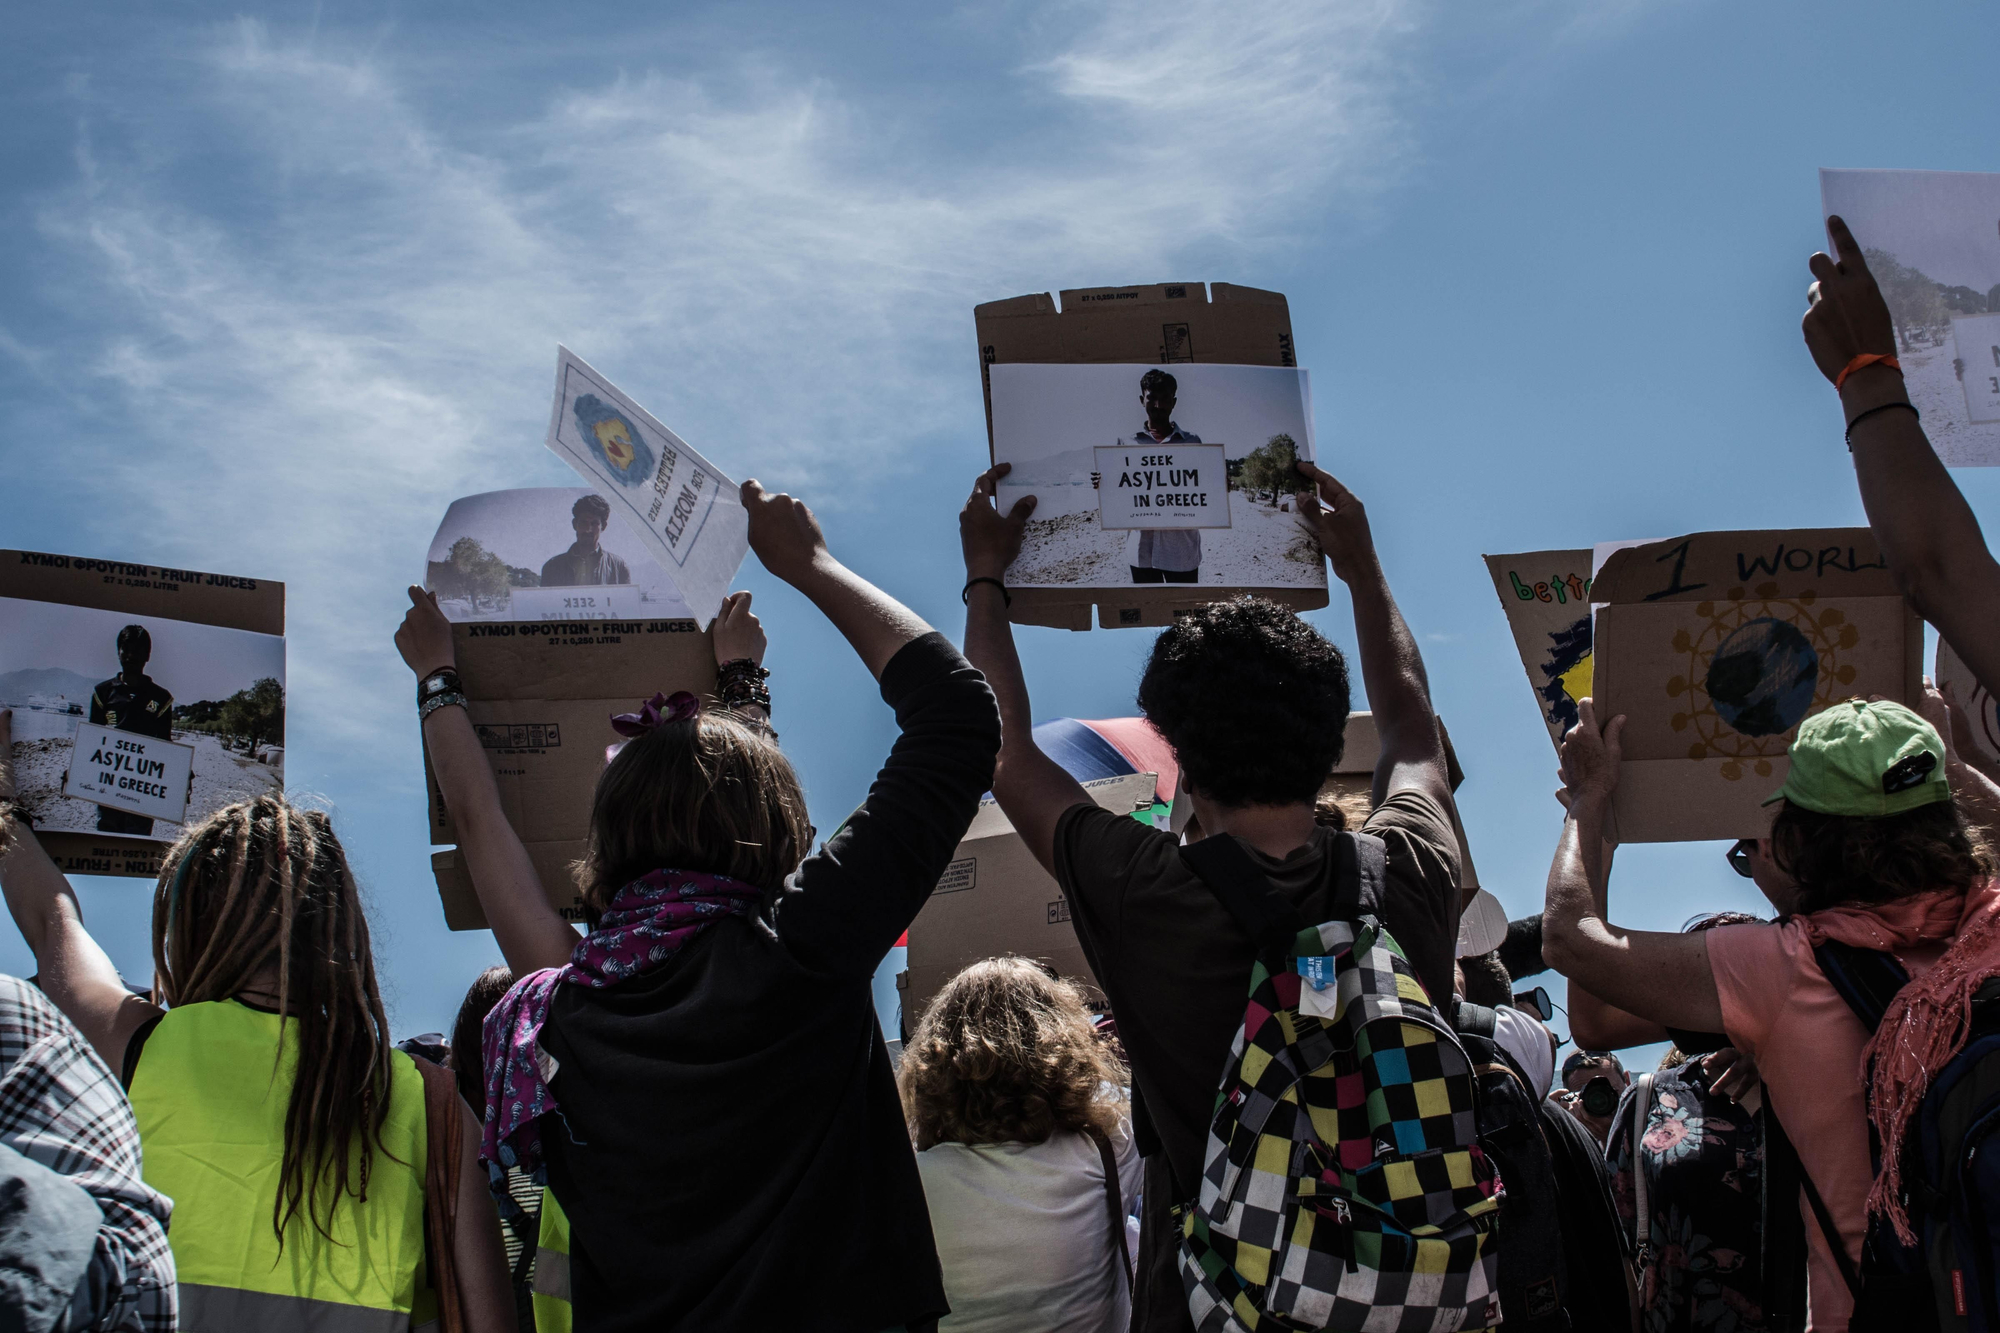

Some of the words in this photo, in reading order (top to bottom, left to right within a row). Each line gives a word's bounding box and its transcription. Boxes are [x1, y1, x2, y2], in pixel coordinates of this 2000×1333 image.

[1124, 456, 1130, 467] I
[1140, 455, 1173, 467] SEEK
[1118, 468, 1199, 491] ASYLUM
[1133, 494, 1151, 508] IN
[1154, 492, 1208, 507] GREECE
[20, 552, 70, 569] ΧΥΜΟΙ
[74, 558, 147, 578] ΦΡΟΥΤΩΝ
[161, 569, 202, 584] FRUIT
[206, 574, 257, 590] JUICES
[1643, 540, 1708, 602] 1
[1737, 543, 1888, 582] WORL
[103, 576, 114, 584] 27
[126, 578, 151, 589] 0,250
[153, 581, 179, 591] LITRE
[468, 622, 516, 637] ΧΥΜΟΙ
[519, 622, 590, 636] ΦΡΟΥΤΩΝ
[602, 622, 644, 635] FRUIT
[646, 621, 696, 634] JUICES
[548, 637, 560, 645] 27
[570, 636, 594, 646] 0,250
[596, 636, 622, 644] LITRE
[102, 736, 107, 746] I
[115, 739, 146, 754] SEEK
[90, 749, 165, 780] ASYLUM
[99, 772, 115, 786] IN
[119, 775, 168, 799] GREECE
[1085, 776, 1125, 788] JUICES
[92, 848, 119, 857] LITRE
[65, 857, 110, 871] FRUIT
